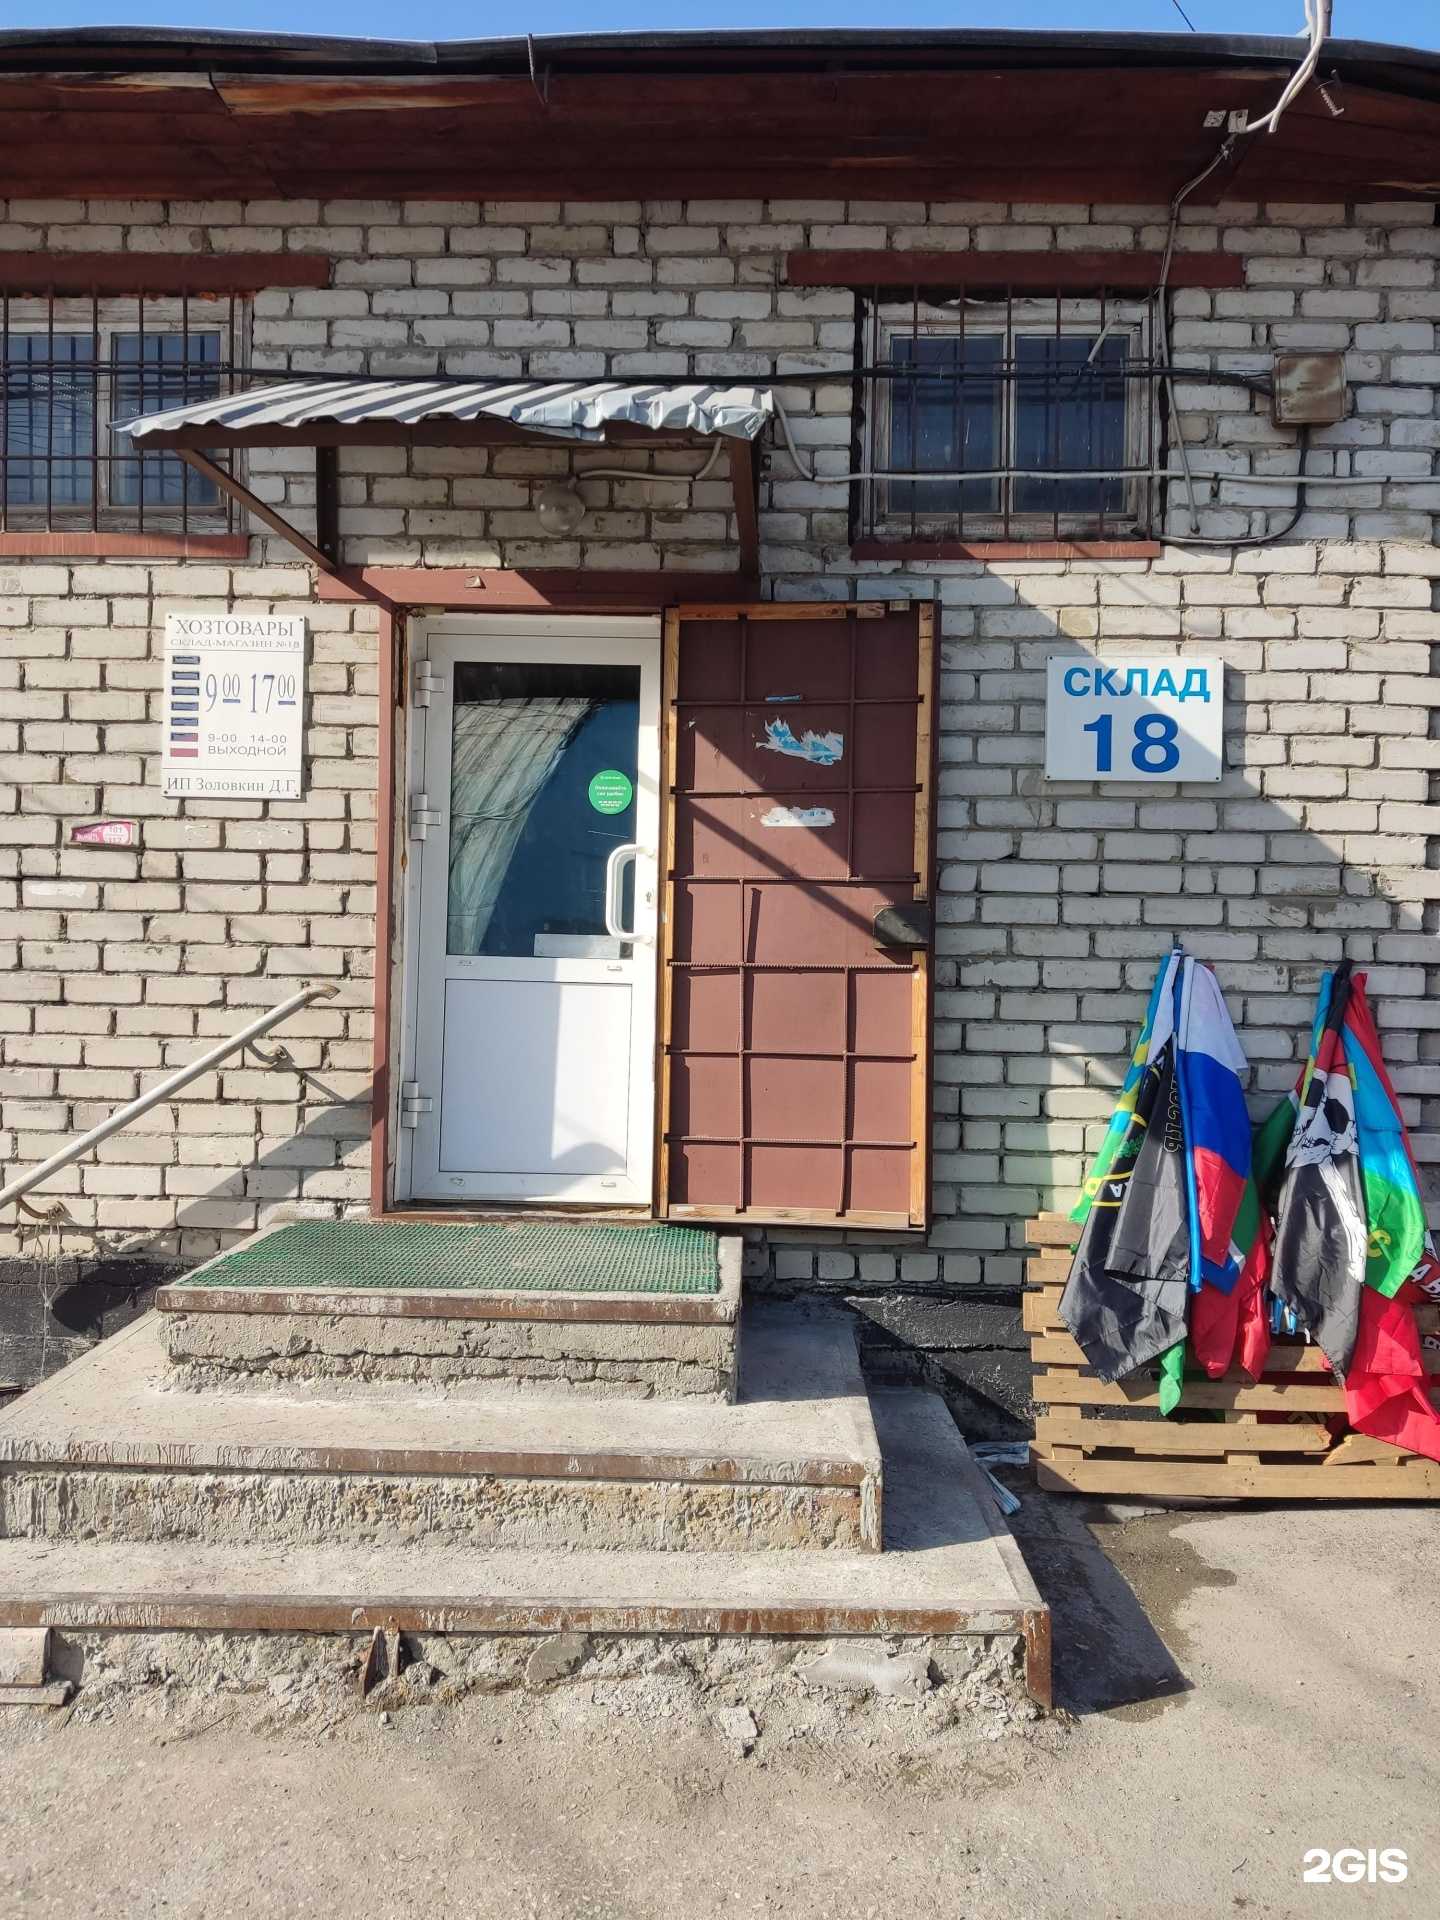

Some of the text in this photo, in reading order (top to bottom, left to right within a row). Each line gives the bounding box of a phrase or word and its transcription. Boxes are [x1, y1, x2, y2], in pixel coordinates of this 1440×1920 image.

[176, 619, 294, 636] ХОЗТОВАРЫ
[1063, 667, 1211, 702] СКЛАД
[207, 744, 287, 756] ВЫХОДНОЙ
[1083, 713, 1180, 773] 18
[167, 777, 191, 790] ИП
